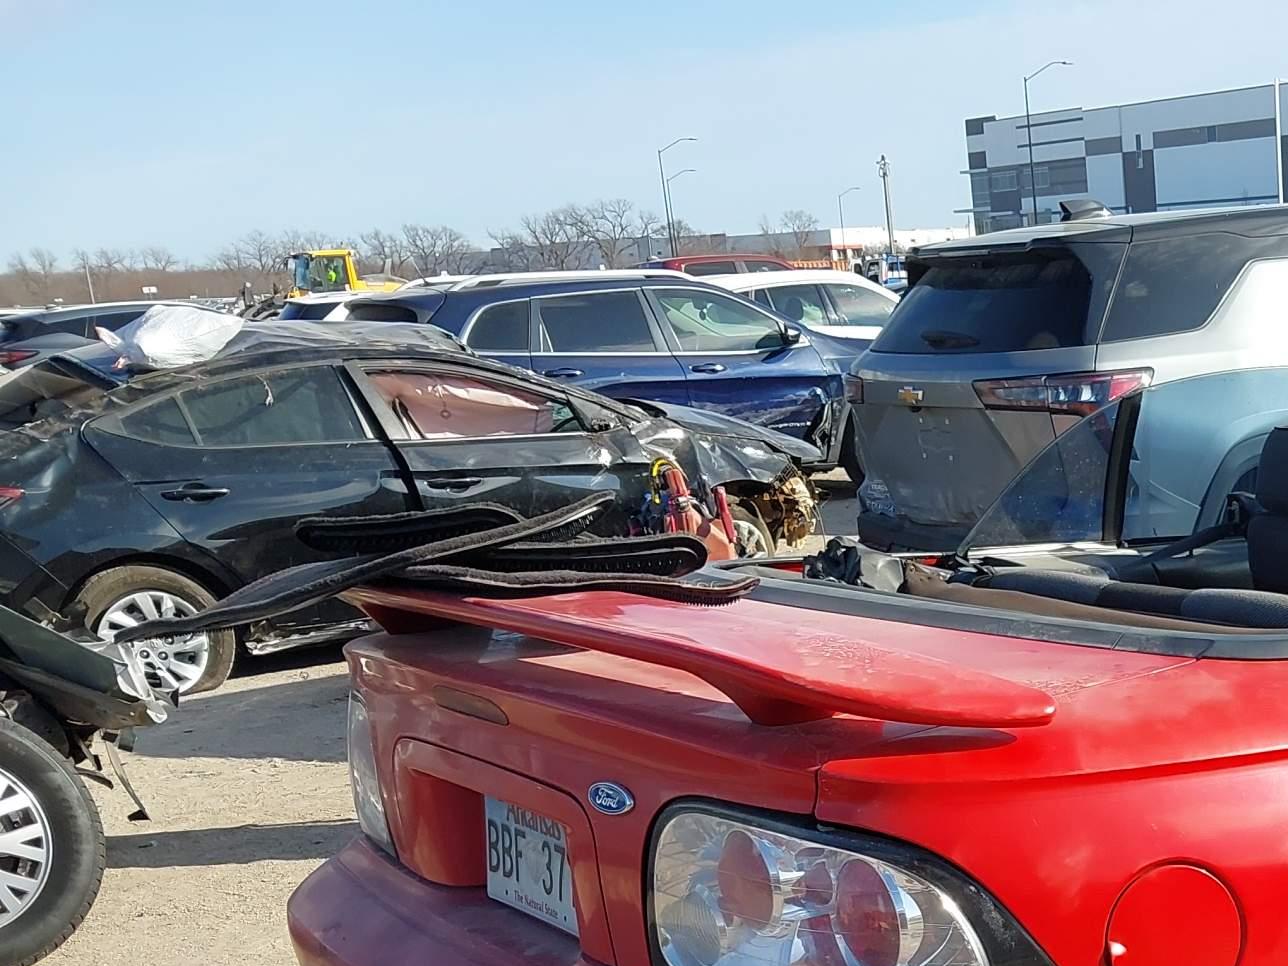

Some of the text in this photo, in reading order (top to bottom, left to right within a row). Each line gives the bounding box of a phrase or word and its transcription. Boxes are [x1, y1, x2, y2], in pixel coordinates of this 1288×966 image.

[487, 818, 575, 908] BBF 37
[513, 889, 524, 903] The
[525, 893, 544, 913] Natural
